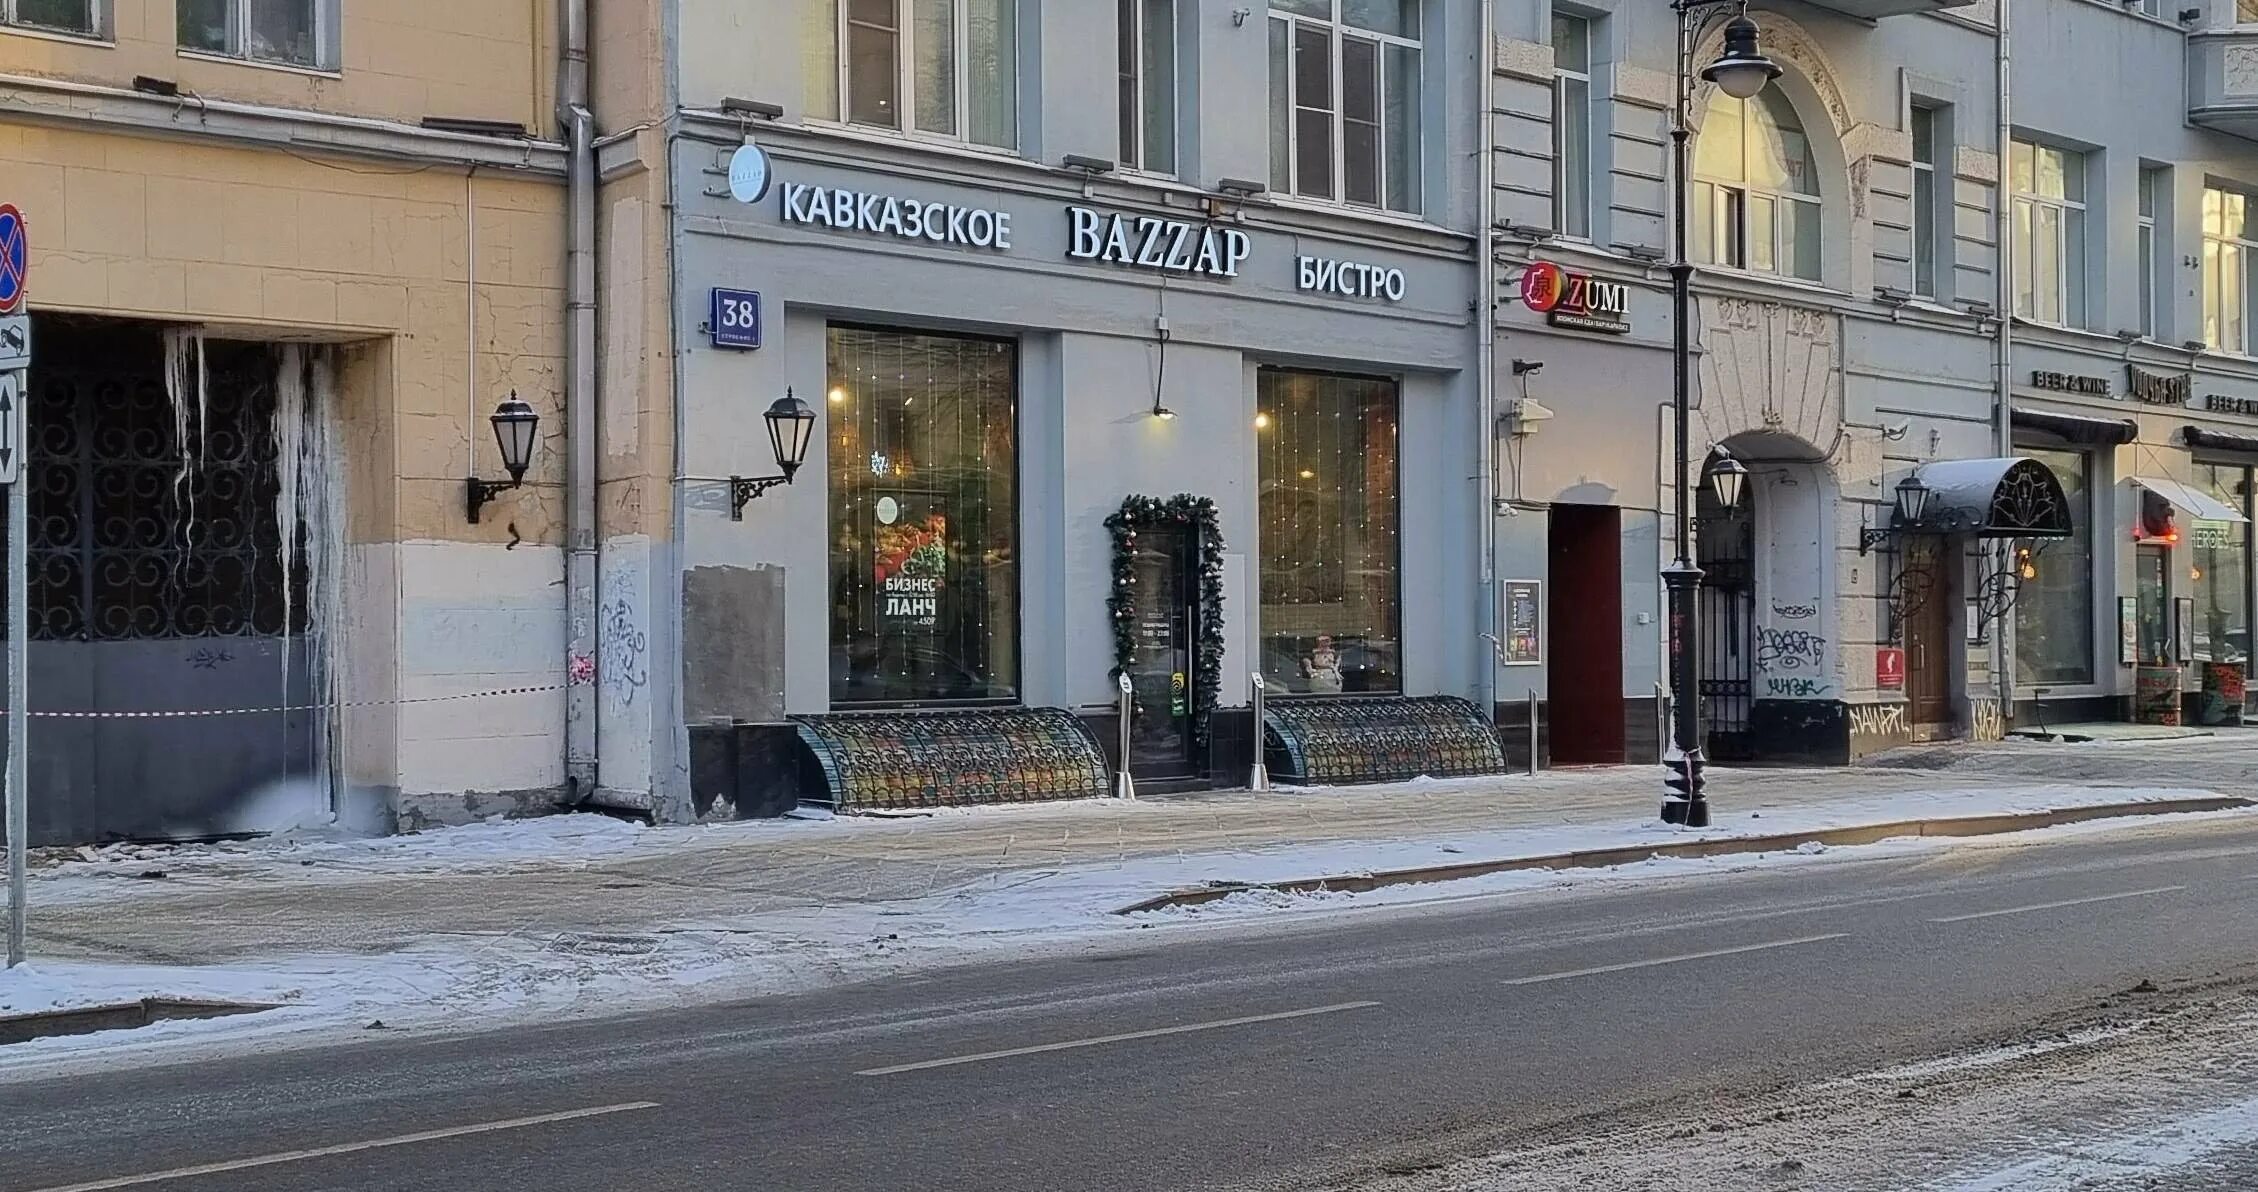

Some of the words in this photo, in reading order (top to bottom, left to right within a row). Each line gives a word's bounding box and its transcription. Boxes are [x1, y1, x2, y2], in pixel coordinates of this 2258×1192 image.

[783, 181, 1011, 249] КАВКАЗСКОЕ
[1068, 205, 1250, 277] BAZZAP
[1299, 255, 1405, 301] БИСТРО
[1563, 277, 1630, 314] ZUMI
[723, 298, 754, 328] 38
[2033, 370, 2067, 390] BEER
[2069, 375, 2081, 391] &
[2083, 376, 2111, 394] WINE
[2210, 395, 2238, 412] BEER
[885, 577, 936, 592] БИЗНЕС
[885, 598, 936, 616] ЛАНЧ
